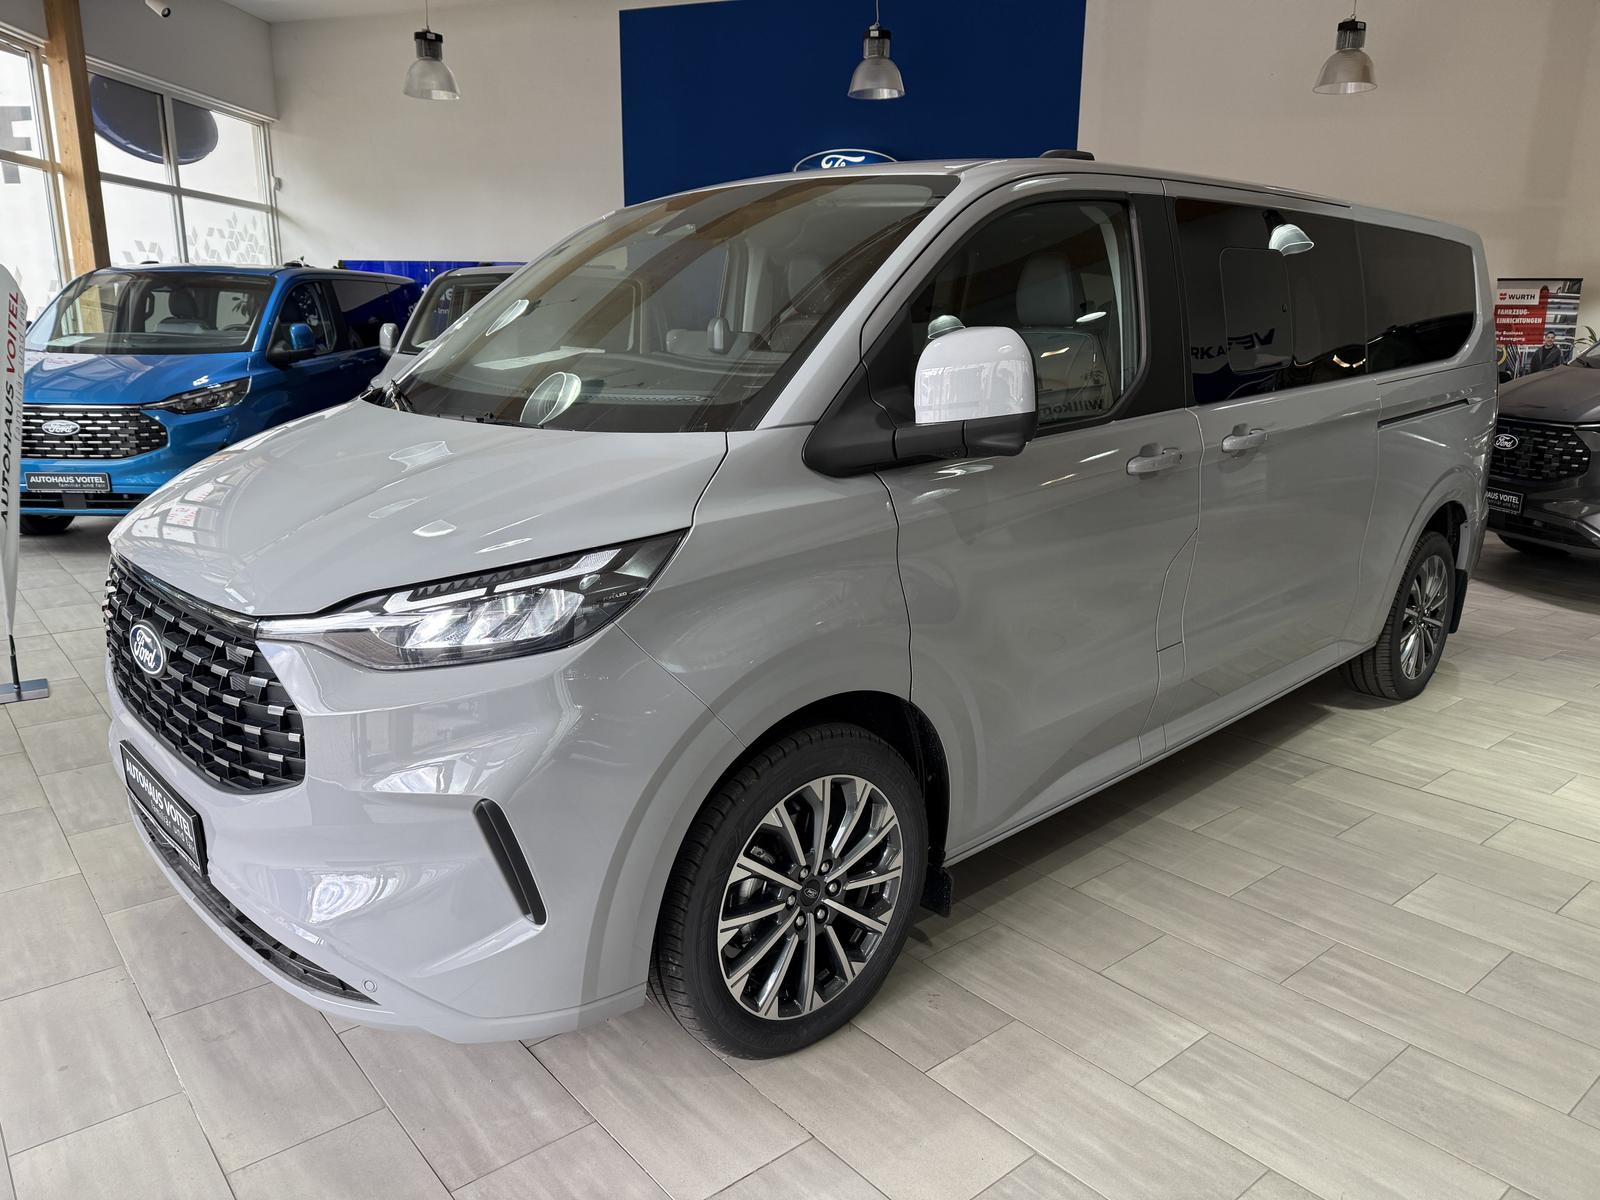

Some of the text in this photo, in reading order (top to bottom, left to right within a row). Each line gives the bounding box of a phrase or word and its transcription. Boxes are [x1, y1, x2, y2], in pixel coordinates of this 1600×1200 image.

[0, 291, 19, 526] AUTOHAUS VOITEL
[1500, 494, 1519, 504] VOITEL
[125, 758, 164, 810] AUTOHAUS
[163, 796, 194, 842] VOITEL
